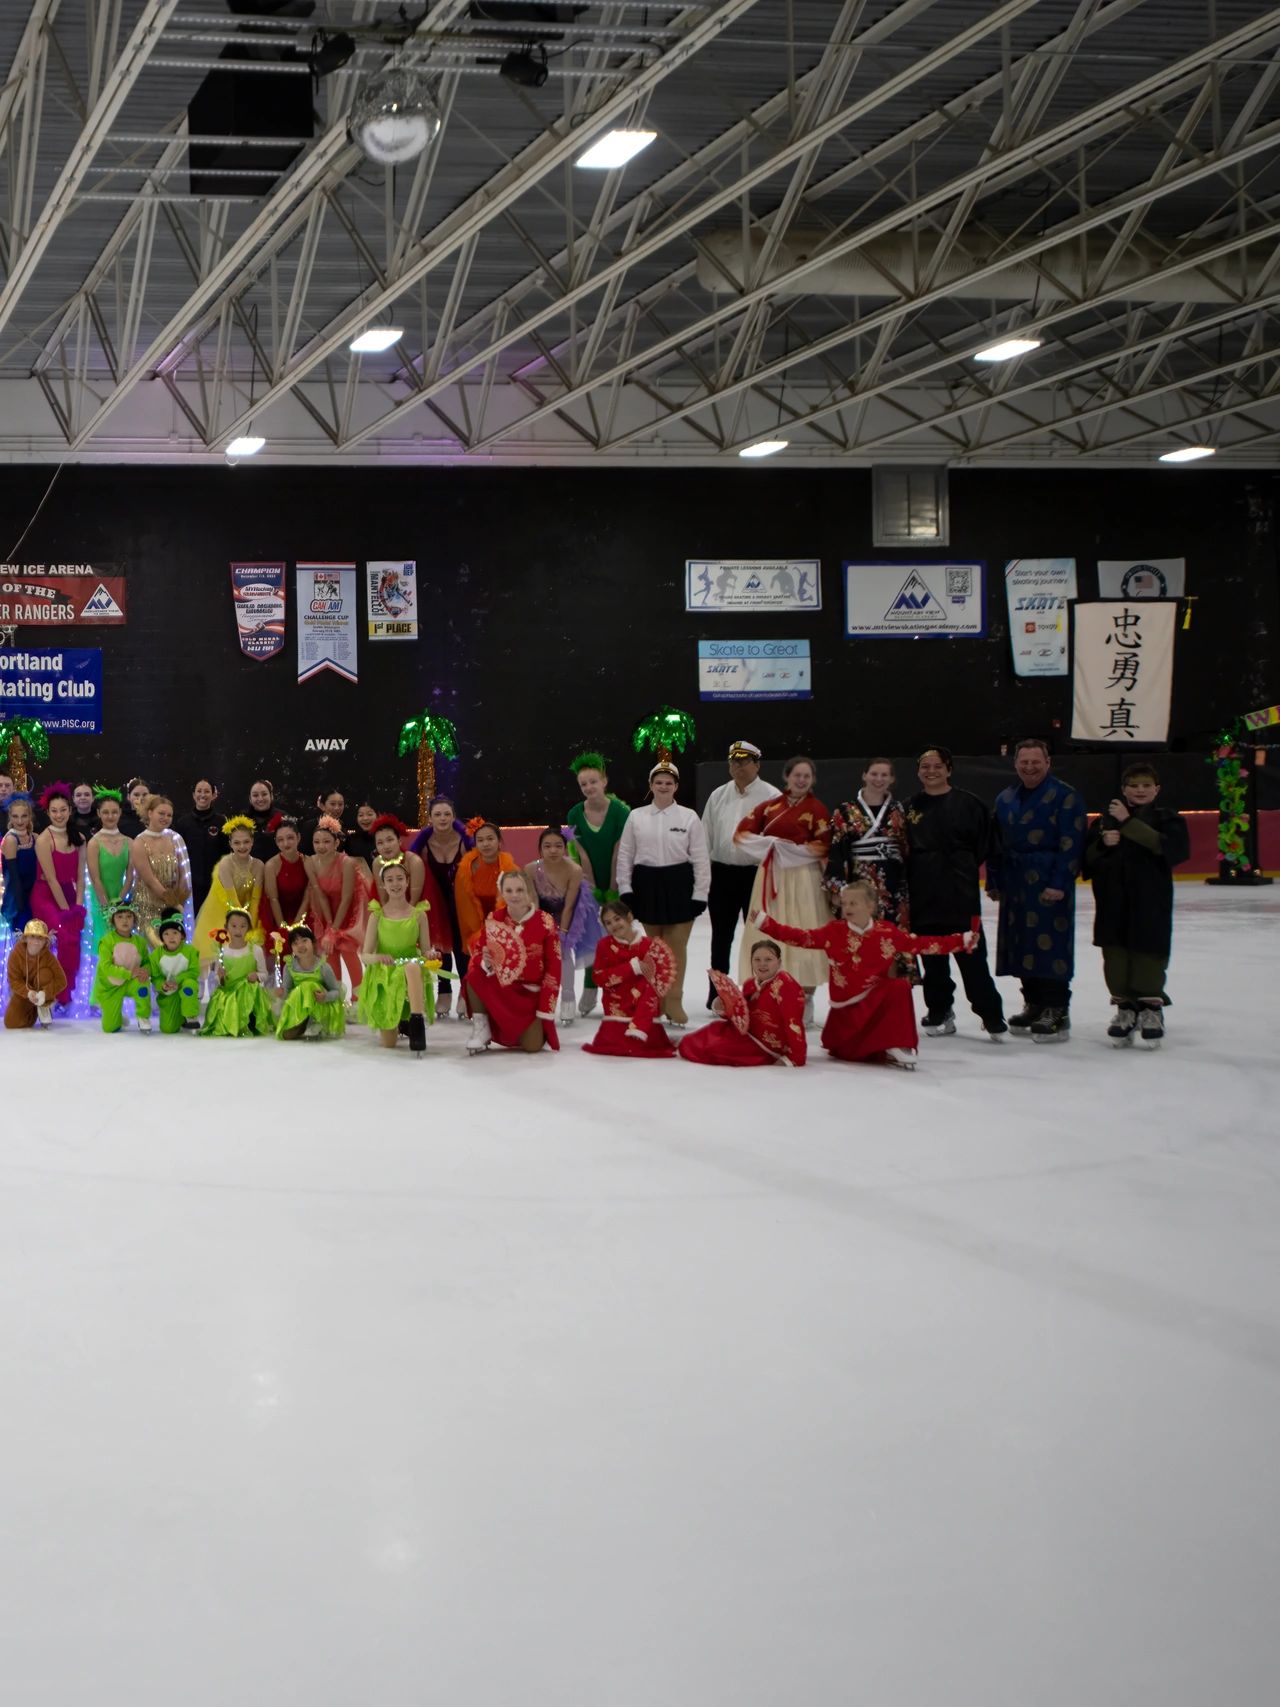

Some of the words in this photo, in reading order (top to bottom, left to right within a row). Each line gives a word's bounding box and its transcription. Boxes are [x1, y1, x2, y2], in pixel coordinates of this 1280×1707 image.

[23, 565, 45, 574] ICE
[49, 565, 94, 574] ARENA
[2, 583, 22, 592] OF
[24, 584, 56, 599] THE
[370, 573, 380, 613] MANTELLO
[1015, 597, 1066, 610] SKATE
[15, 604, 75, 620] RANGERS
[386, 623, 412, 633] PLACE
[709, 643, 744, 656] Skate
[747, 643, 760, 655] to
[763, 643, 799, 655] Great
[706, 665, 738, 673] SKATE
[1099, 607, 1142, 738] 忠勇真
[57, 680, 96, 697] Club
[304, 739, 349, 750] AWAY
